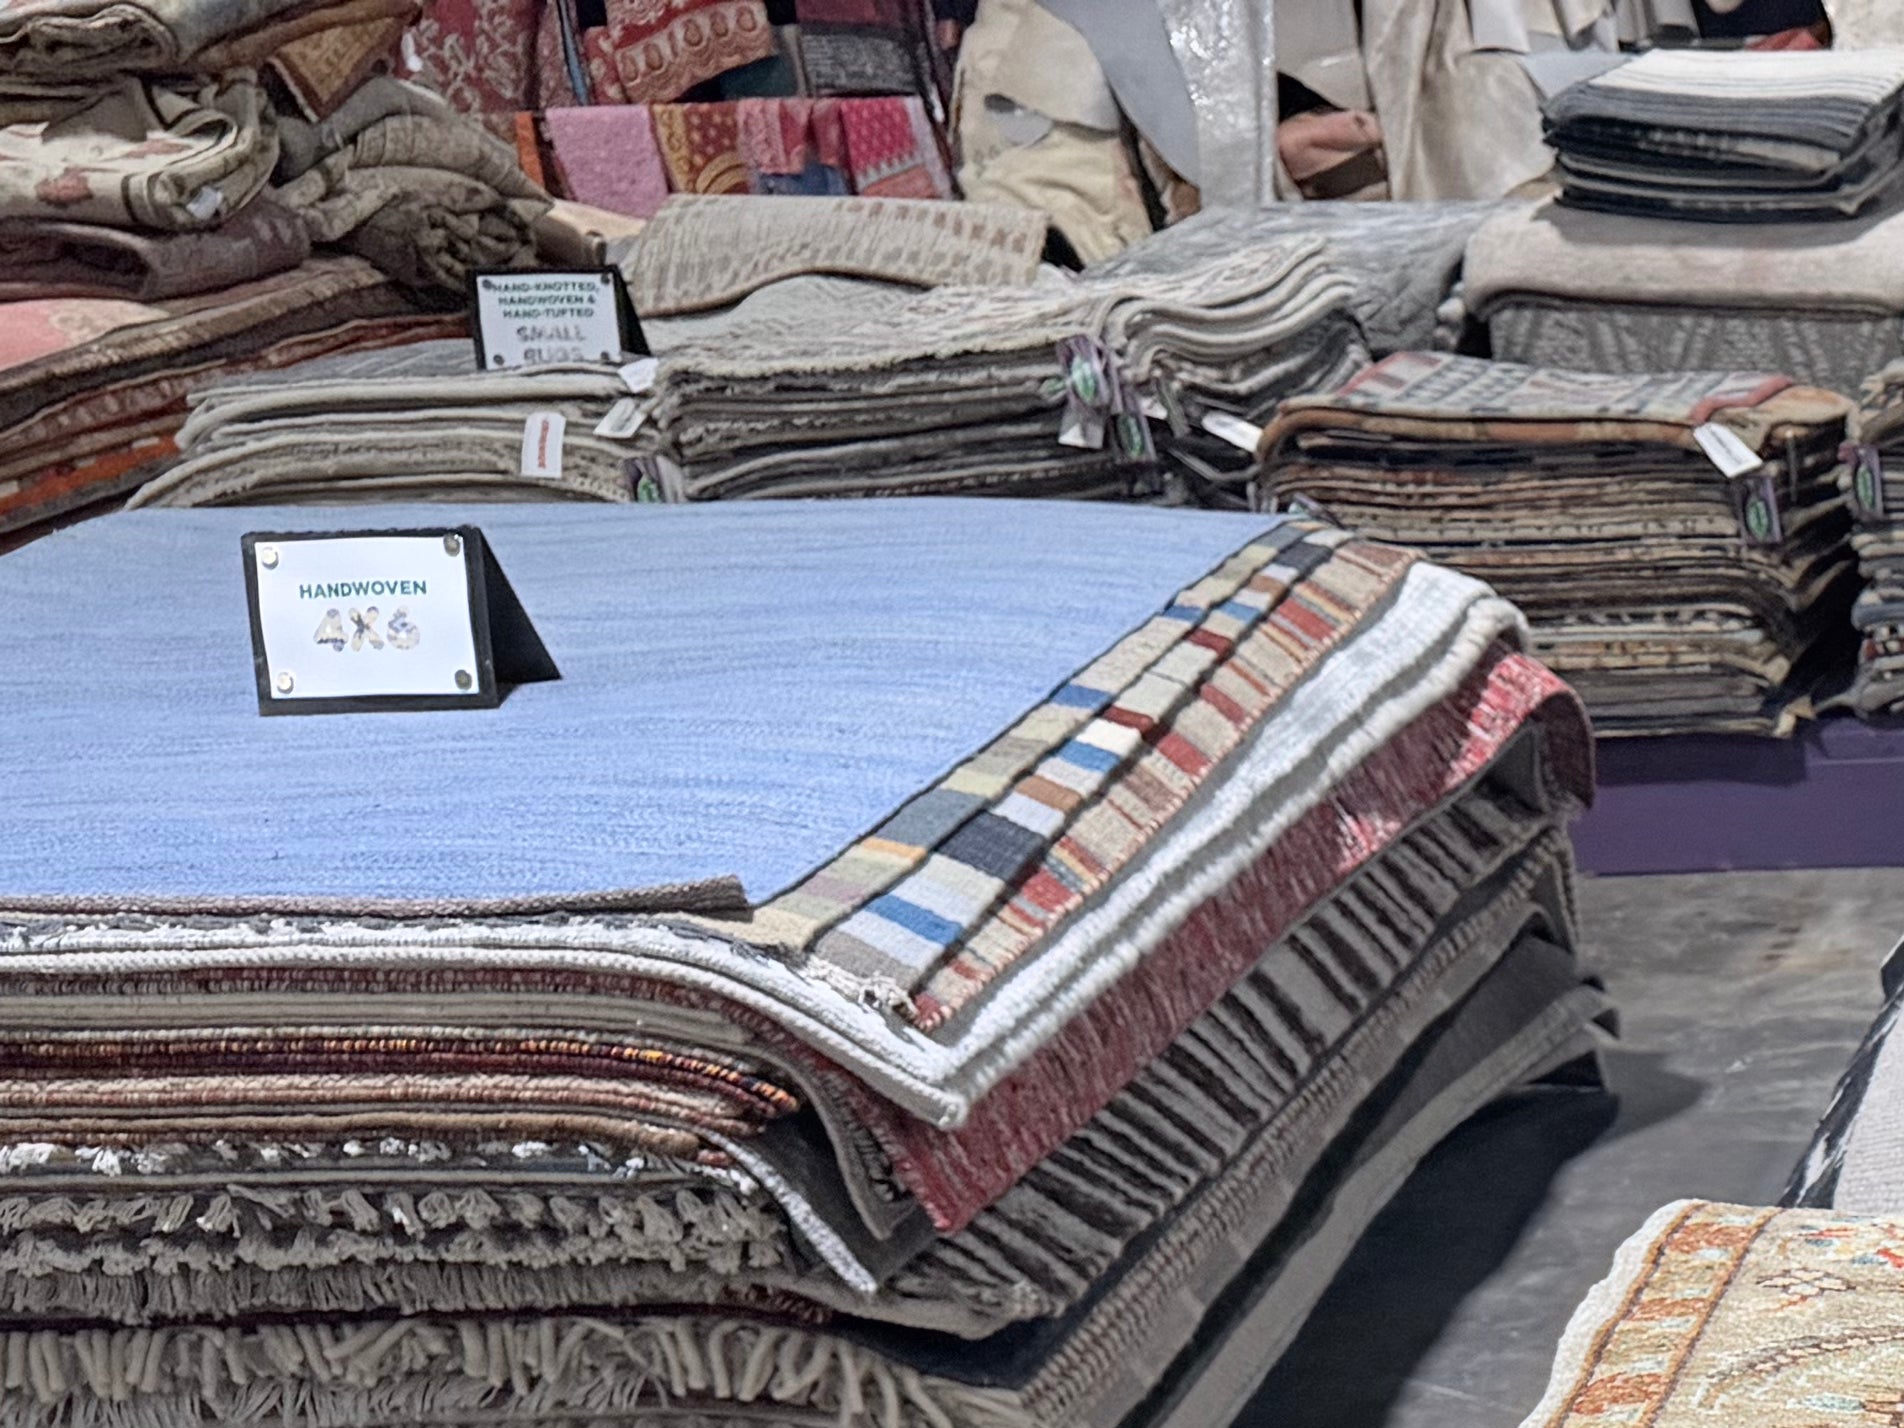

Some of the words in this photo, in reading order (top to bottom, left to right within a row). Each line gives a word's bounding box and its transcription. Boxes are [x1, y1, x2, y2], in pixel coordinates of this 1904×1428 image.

[498, 295, 583, 306] HANDWOVEN
[503, 308, 594, 318] HAND-TUFTED
[516, 325, 585, 342] SMALL
[300, 580, 427, 599] HANDWOVEN
[313, 605, 420, 652] 4X6
